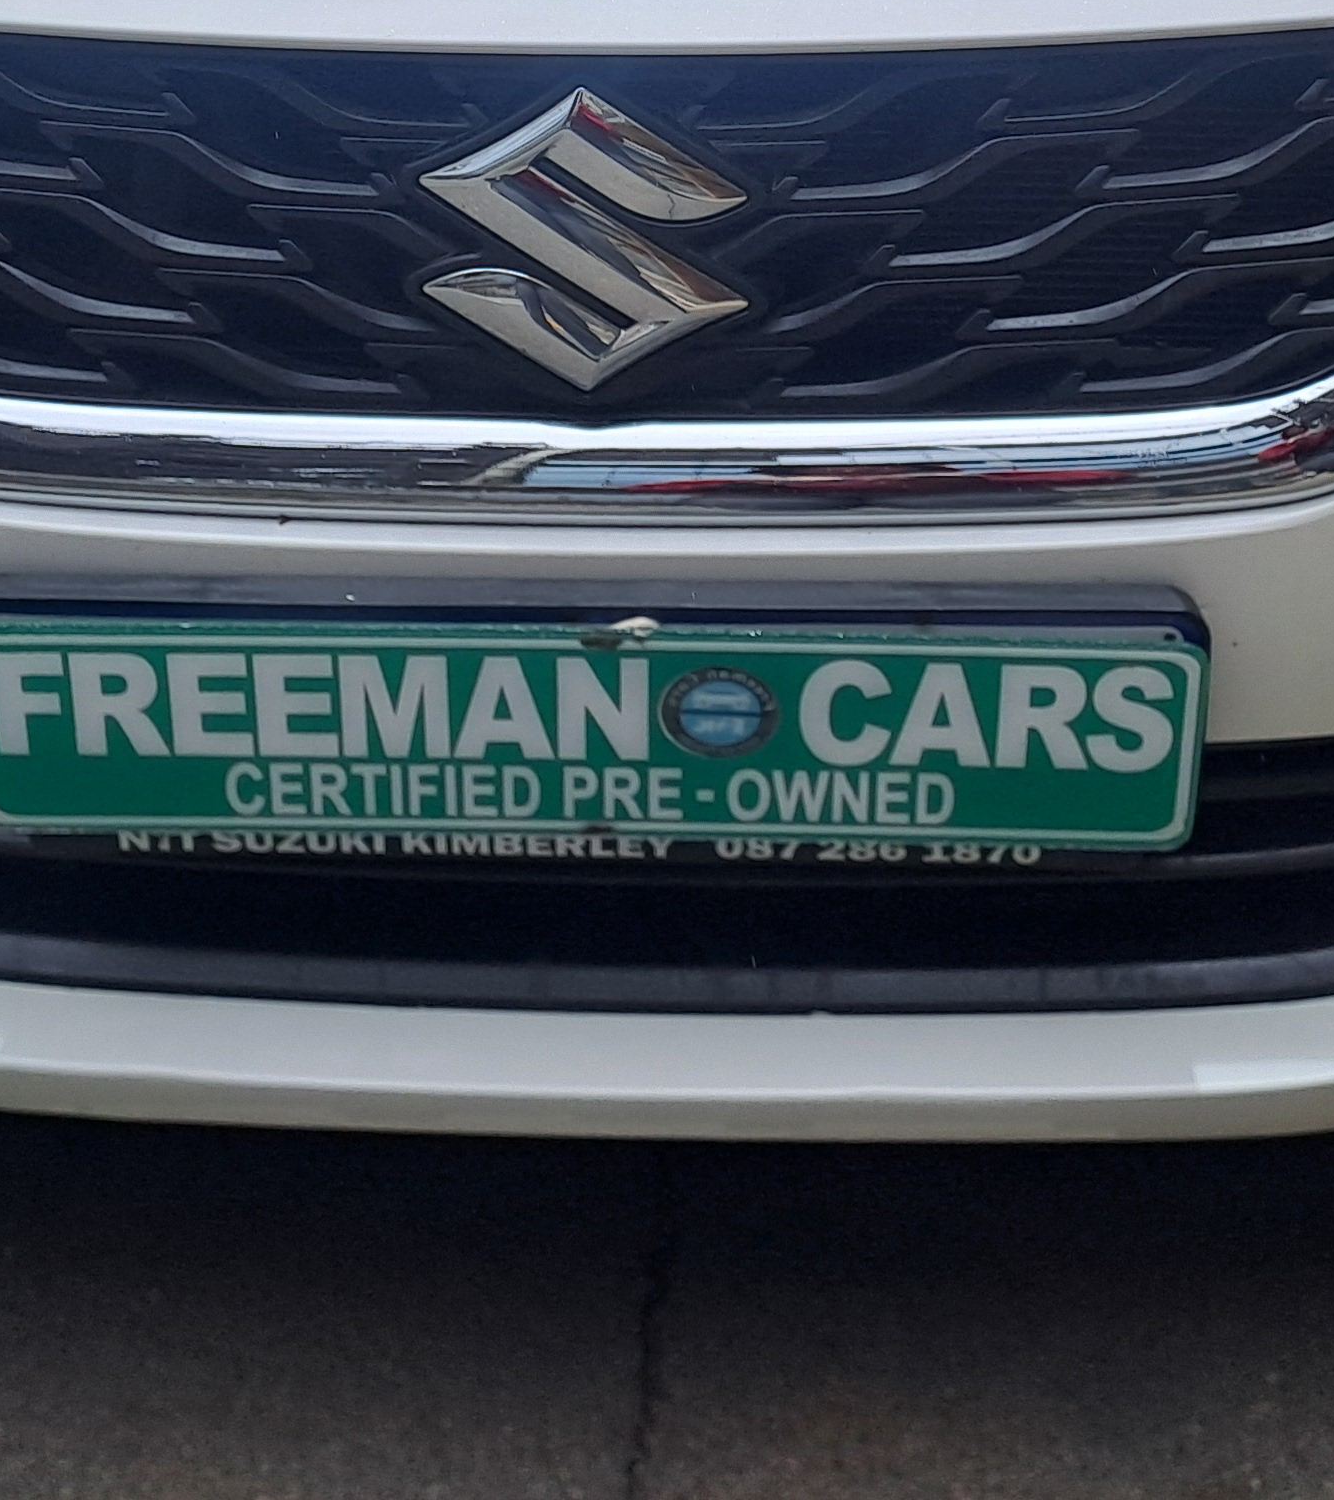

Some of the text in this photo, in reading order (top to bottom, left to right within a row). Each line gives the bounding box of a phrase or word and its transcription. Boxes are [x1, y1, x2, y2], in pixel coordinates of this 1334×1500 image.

[799, 660, 1174, 773] CARS
[225, 762, 540, 818] CERTIFIED
[564, 765, 683, 821] PRE
[727, 769, 955, 826] OWNED
[210, 831, 385, 855] SUZUKI
[400, 832, 675, 859] KIMBERLEY
[921, 840, 1043, 865] 1870
